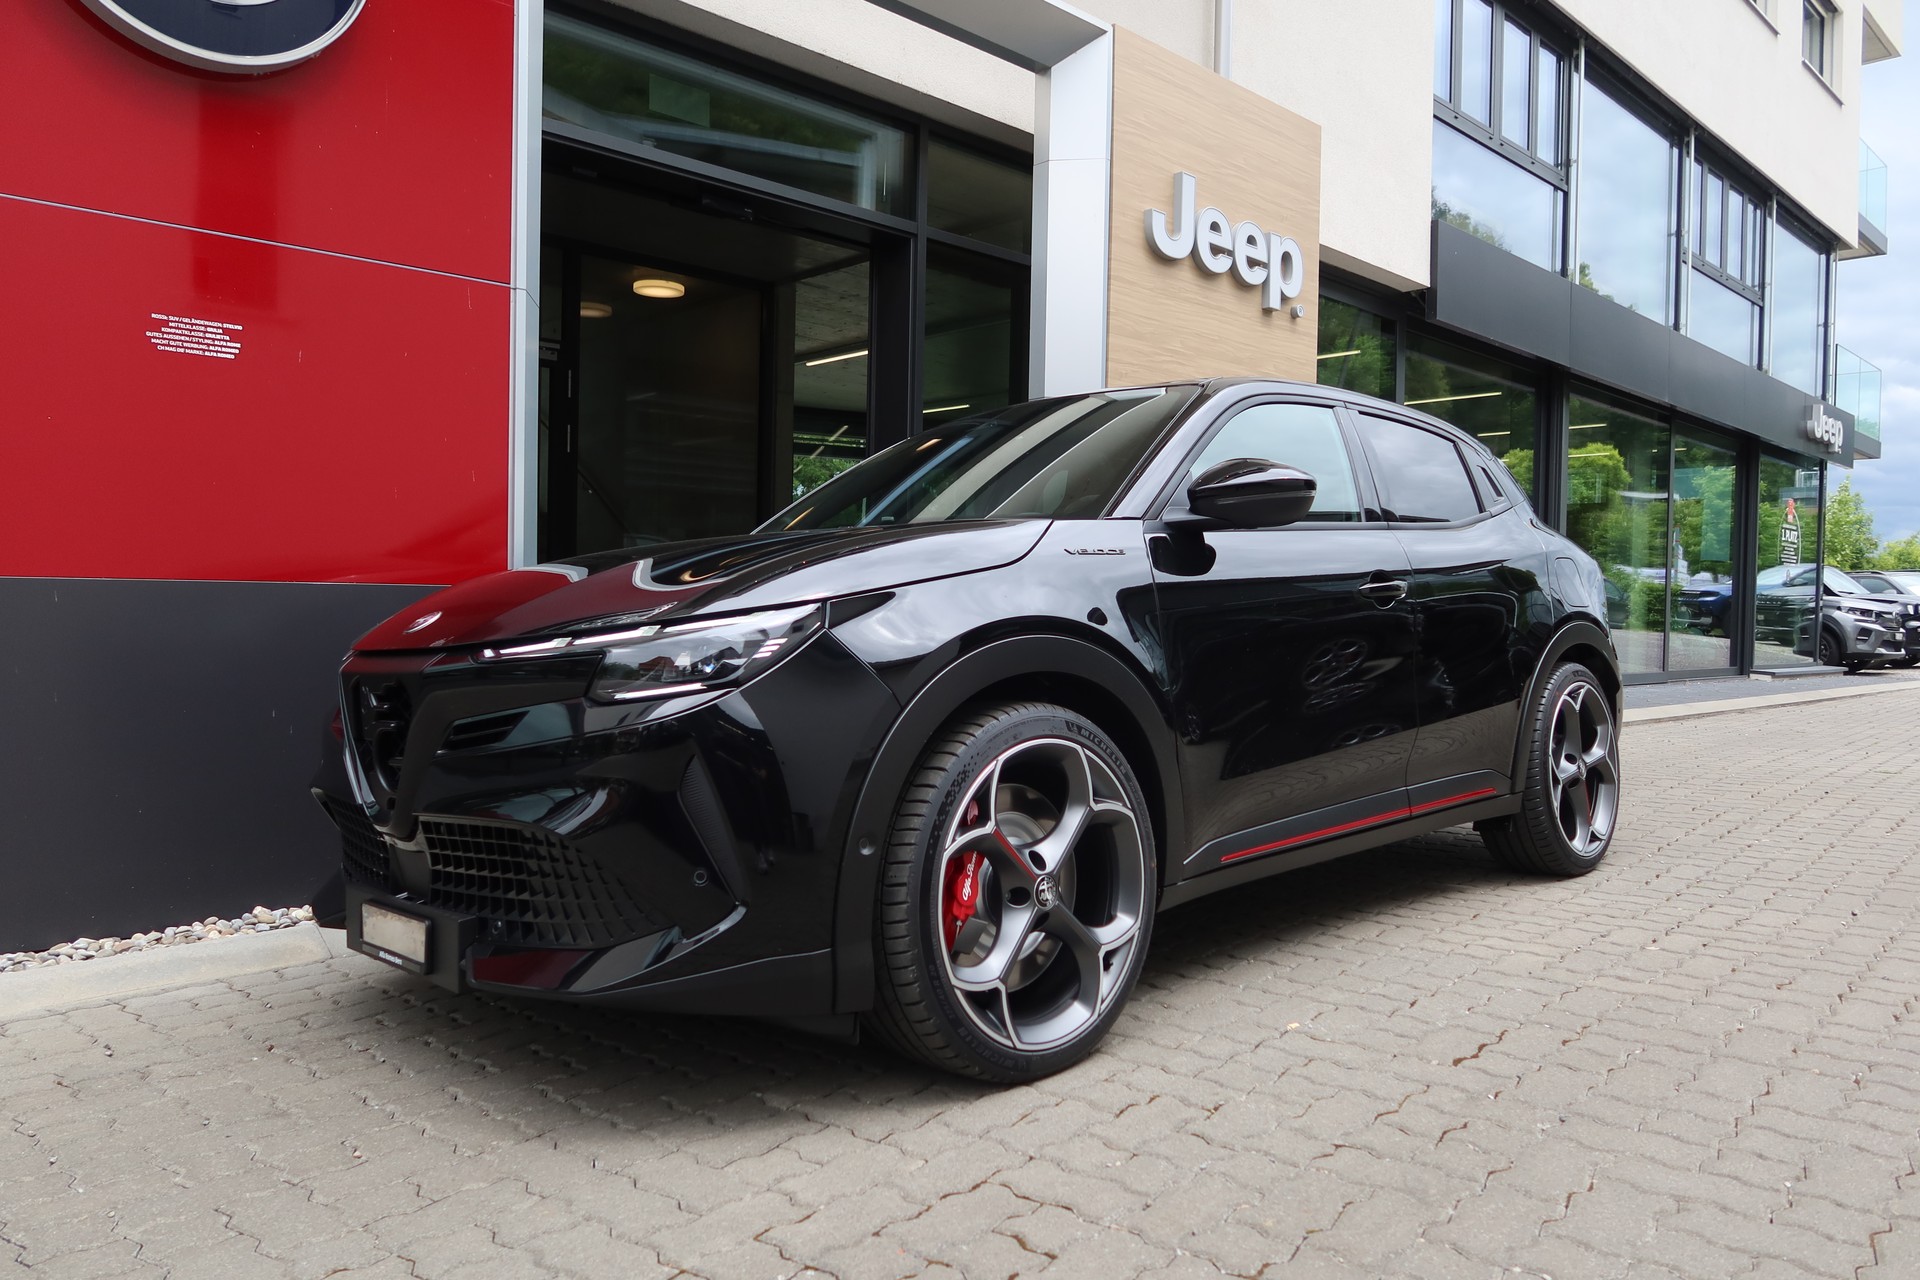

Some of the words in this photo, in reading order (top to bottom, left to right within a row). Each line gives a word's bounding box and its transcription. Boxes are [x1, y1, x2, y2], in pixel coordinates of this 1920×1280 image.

[1144, 171, 1303, 312] Jeep
[145, 331, 163, 339] GUTES
[222, 322, 243, 331] STELVIO
[1807, 403, 1843, 453] Jeep
[1080, 728, 1127, 775] MICHELIN
